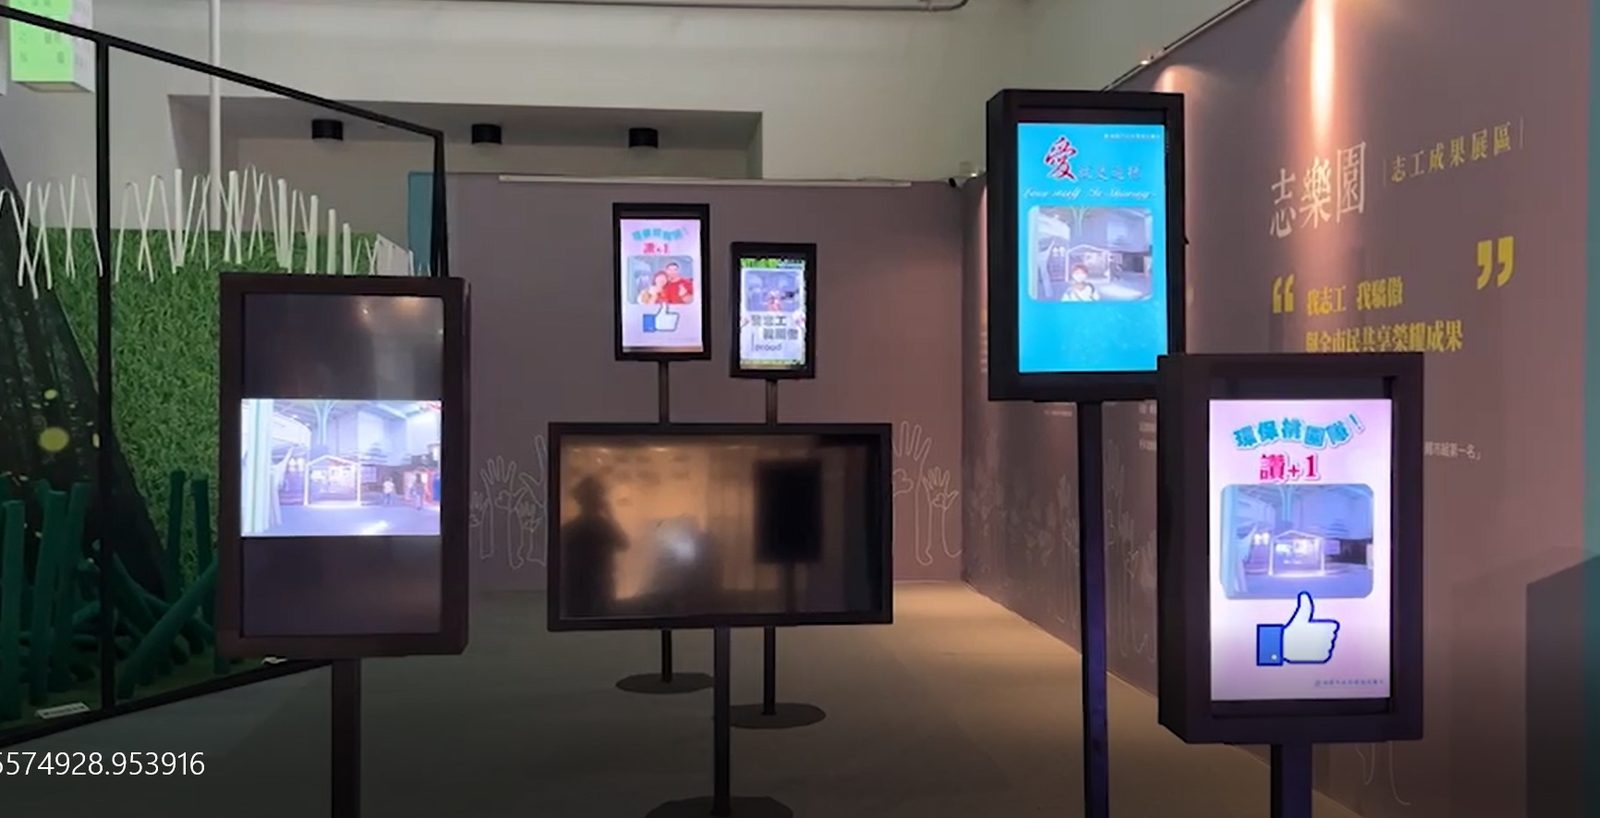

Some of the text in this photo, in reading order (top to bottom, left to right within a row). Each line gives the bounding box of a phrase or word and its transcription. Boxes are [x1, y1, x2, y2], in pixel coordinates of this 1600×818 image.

[1270, 141, 1366, 238] 志樂園
[1391, 121, 1511, 183] 志工成果展區
